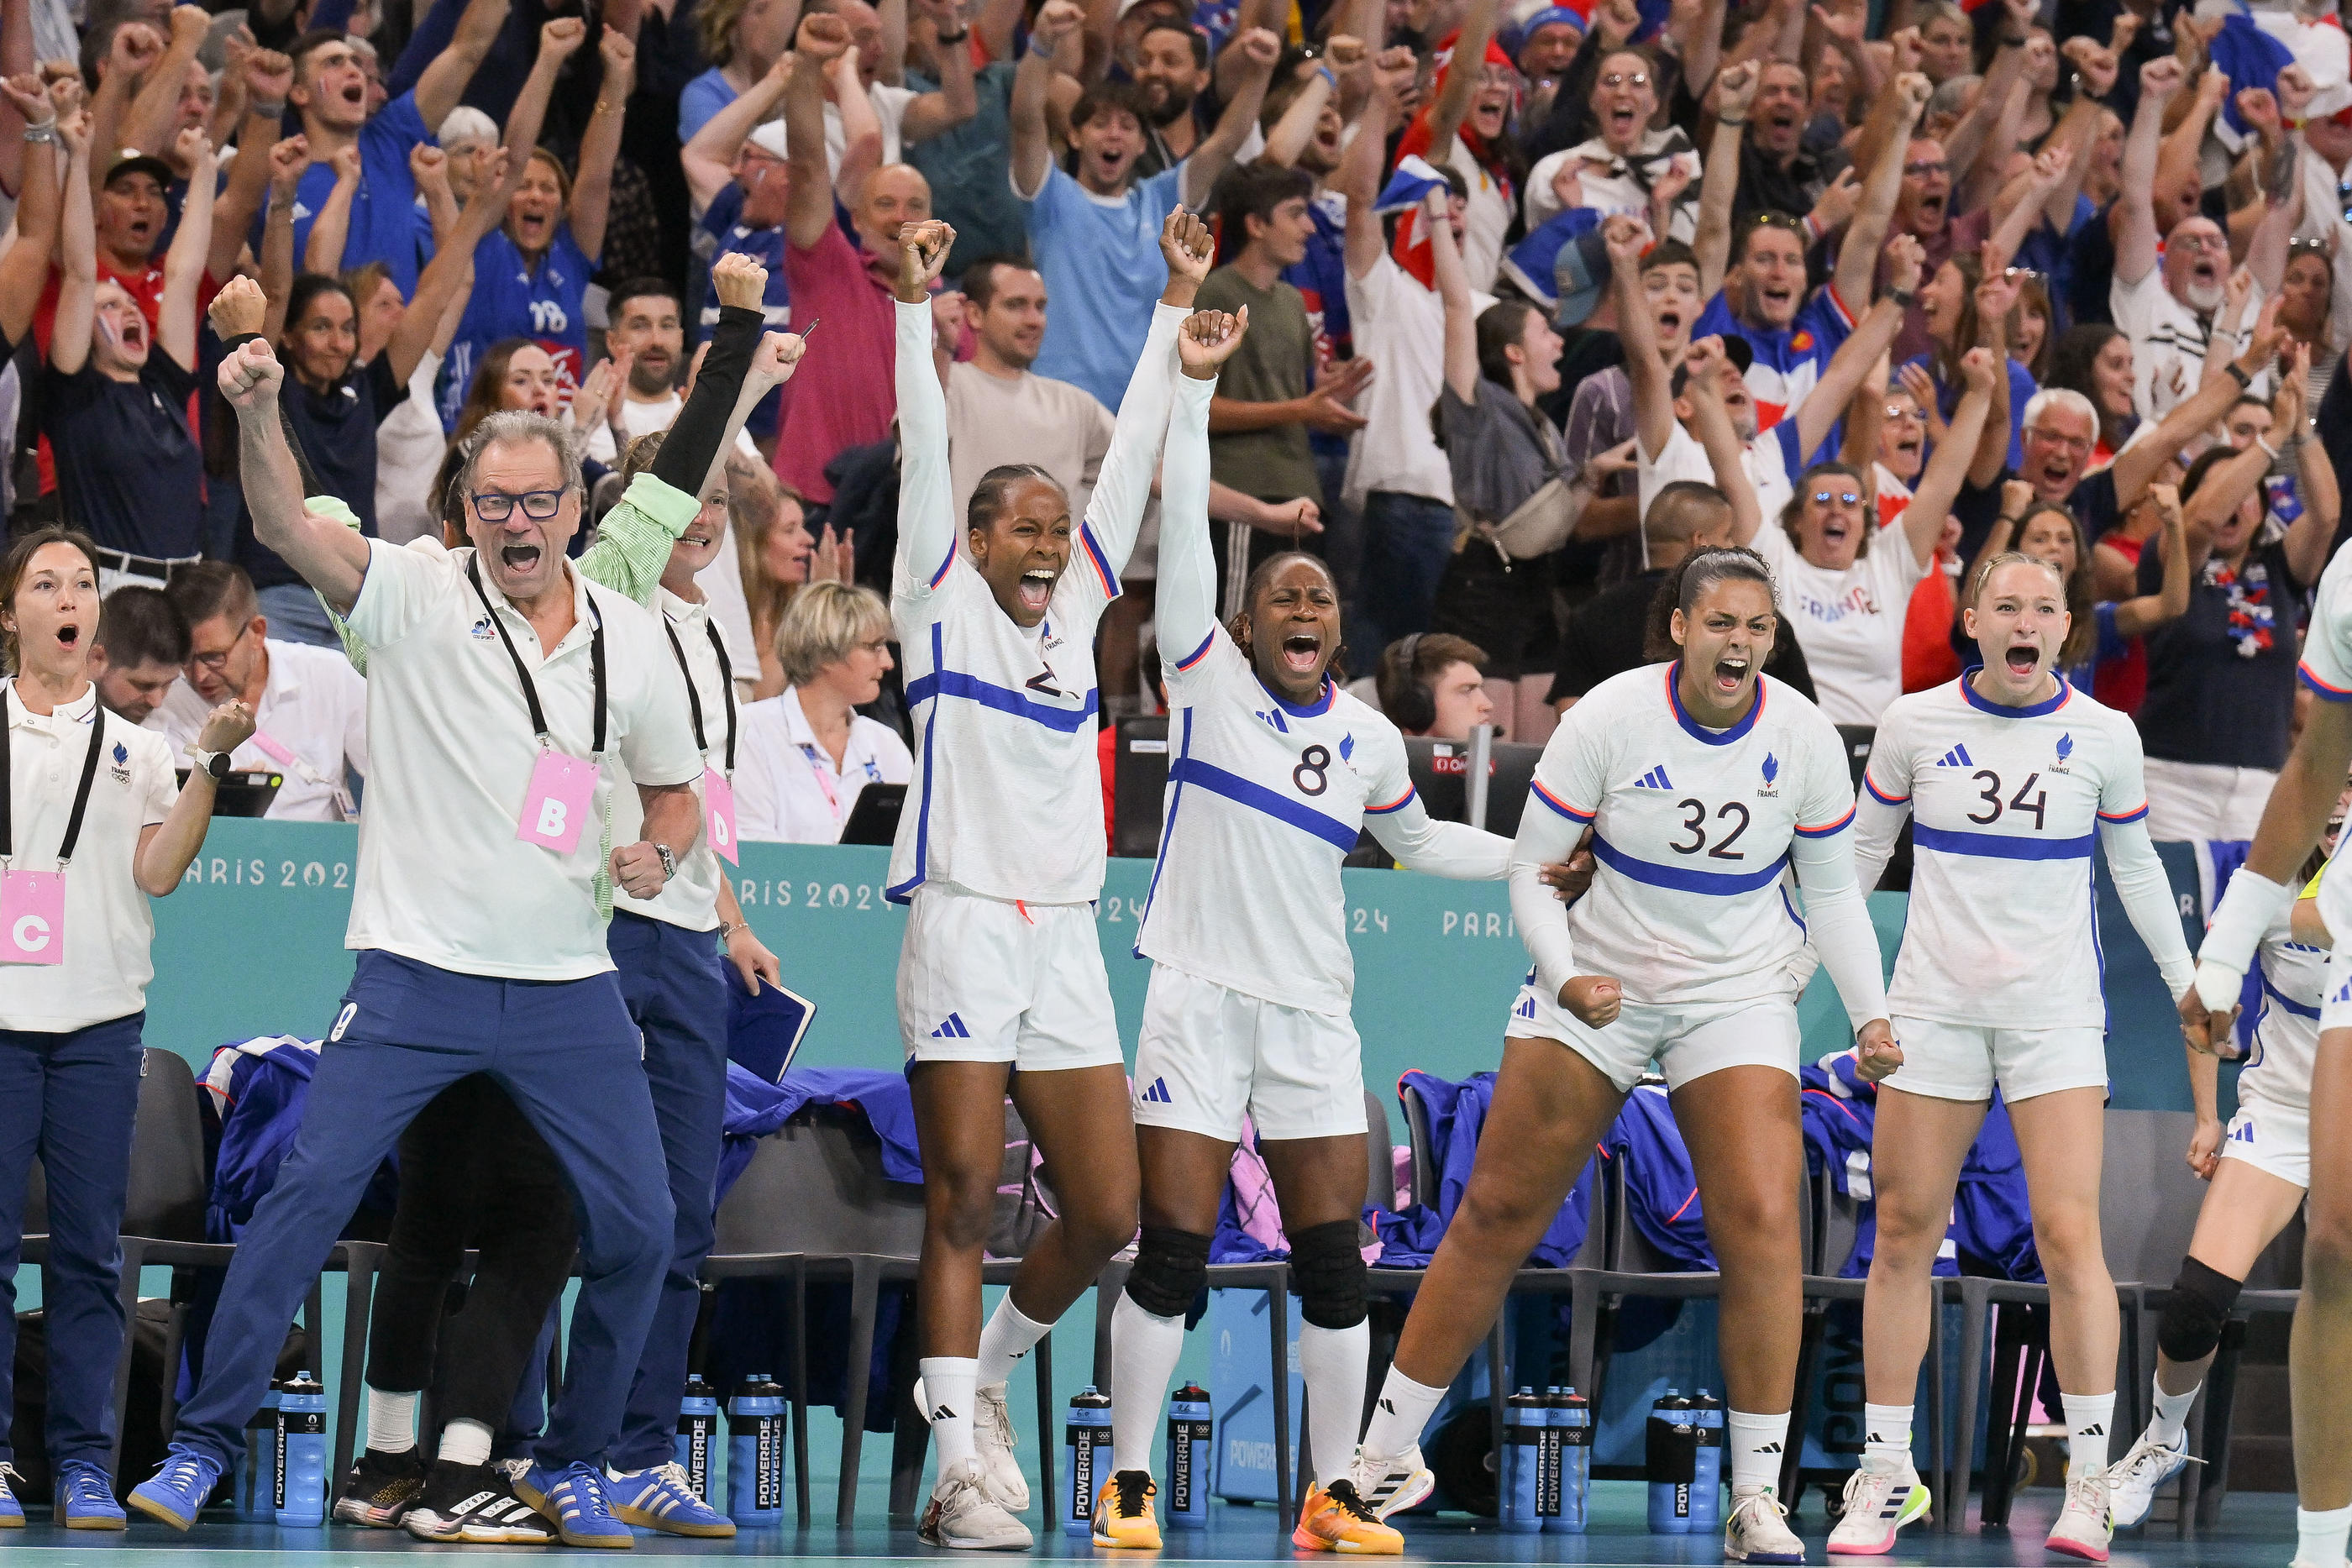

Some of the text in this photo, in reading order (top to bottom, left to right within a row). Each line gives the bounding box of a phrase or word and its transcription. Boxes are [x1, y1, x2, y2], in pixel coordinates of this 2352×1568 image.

[111, 765, 130, 777] FRANCE
[1292, 744, 1331, 797] 8
[1756, 789, 1779, 798] FRANCE
[2048, 763, 2071, 775] FRANCE
[536, 796, 568, 837] B
[1966, 769, 2047, 831] 34
[713, 809, 729, 847] D
[1668, 798, 1751, 860] 32
[281, 860, 349, 888] 202
[12, 915, 50, 952] C
[276, 1415, 285, 1504] POWERADE
[759, 1420, 771, 1506] POWERADE
[1075, 1430, 1090, 1517] POWERADE
[1175, 1424, 1189, 1508] POWERADE
[1229, 1439, 1298, 1473] POWERE
[1537, 1430, 1547, 1513] POWERADE
[1547, 1430, 1560, 1513] POWERADE
